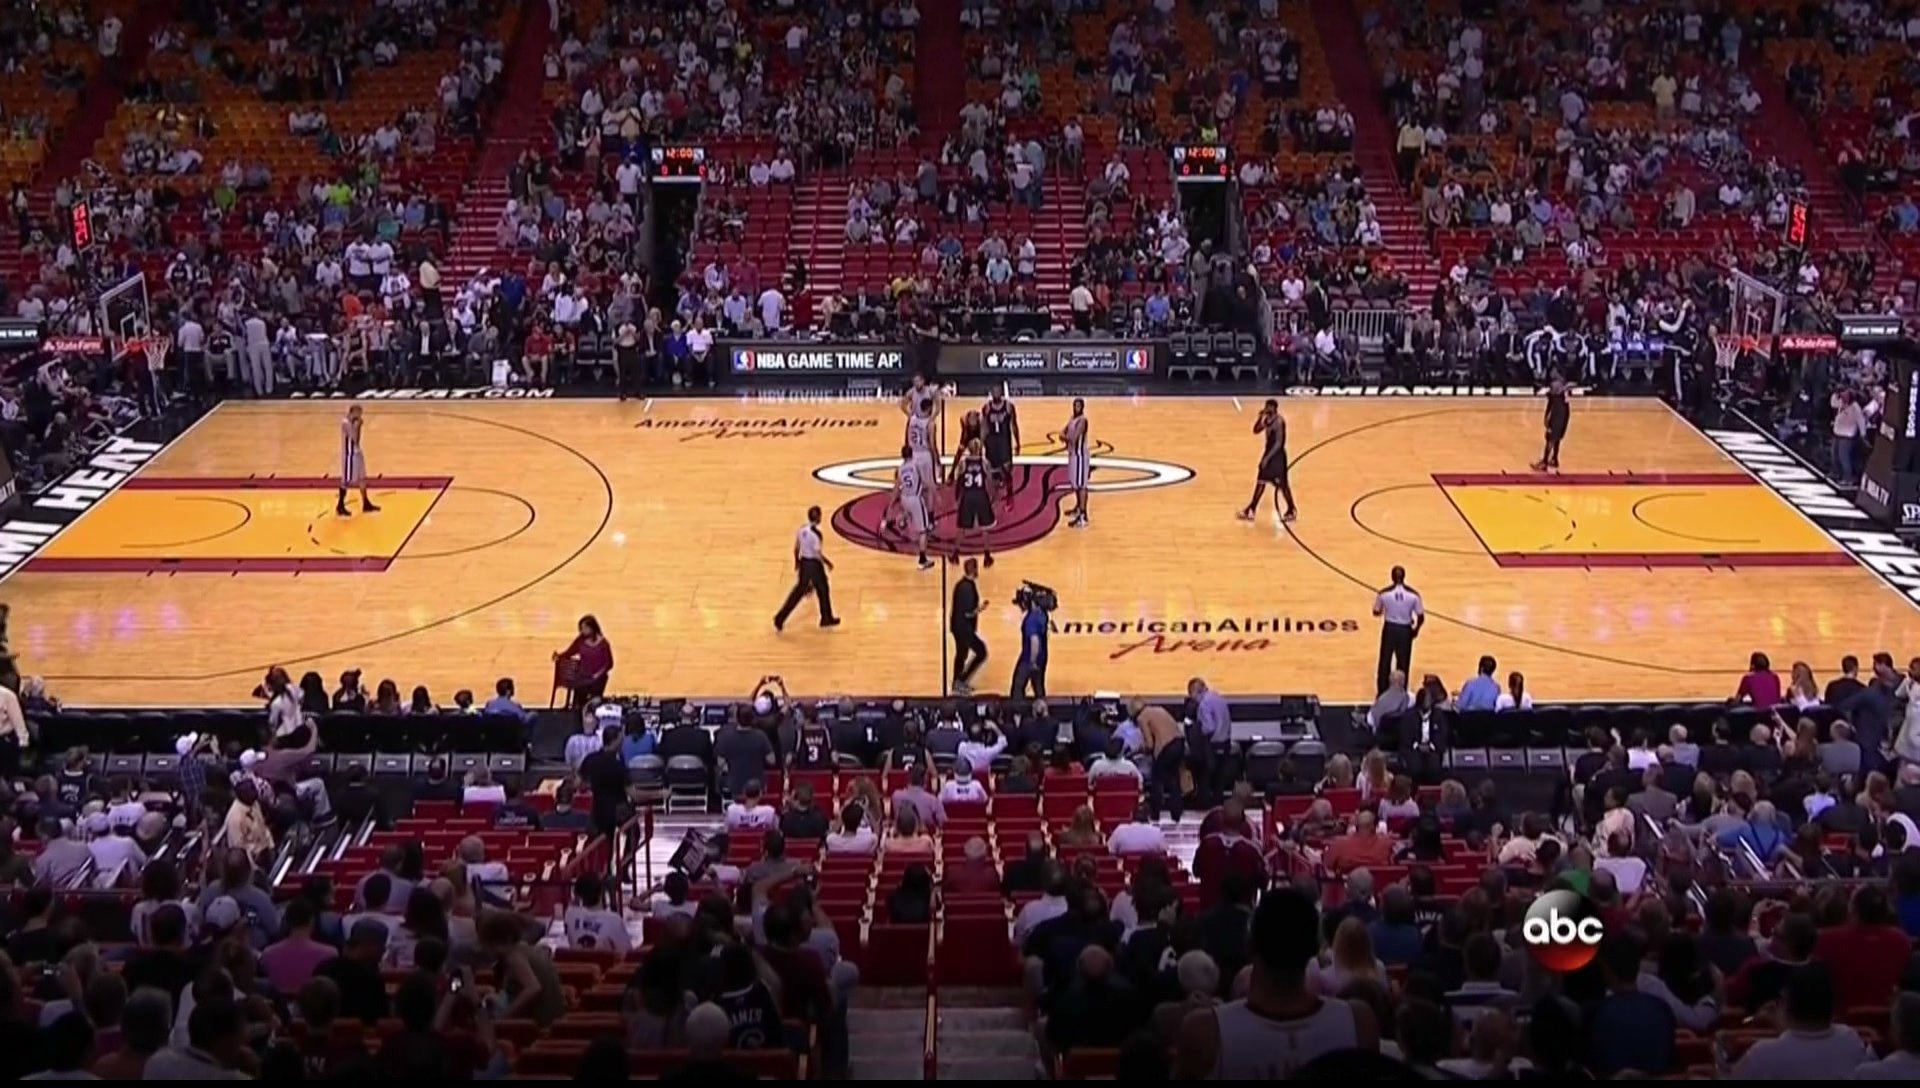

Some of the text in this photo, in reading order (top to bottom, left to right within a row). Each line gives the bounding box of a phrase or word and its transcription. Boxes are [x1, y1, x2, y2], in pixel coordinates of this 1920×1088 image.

[666, 147, 693, 159] 12:00
[1188, 147, 1216, 159] 12:00
[757, 352, 785, 369] NBA
[787, 352, 833, 369] GAME
[835, 352, 875, 369] TIME
[1002, 358, 1045, 369] App Store
[1072, 357, 1098, 370] Google
[33, 436, 164, 510] HEAT
[964, 473, 983, 487] 34
[1704, 430, 1870, 519] MIAMI
[1109, 634, 1275, 660] Arena
[807, 746, 819, 763] 3
